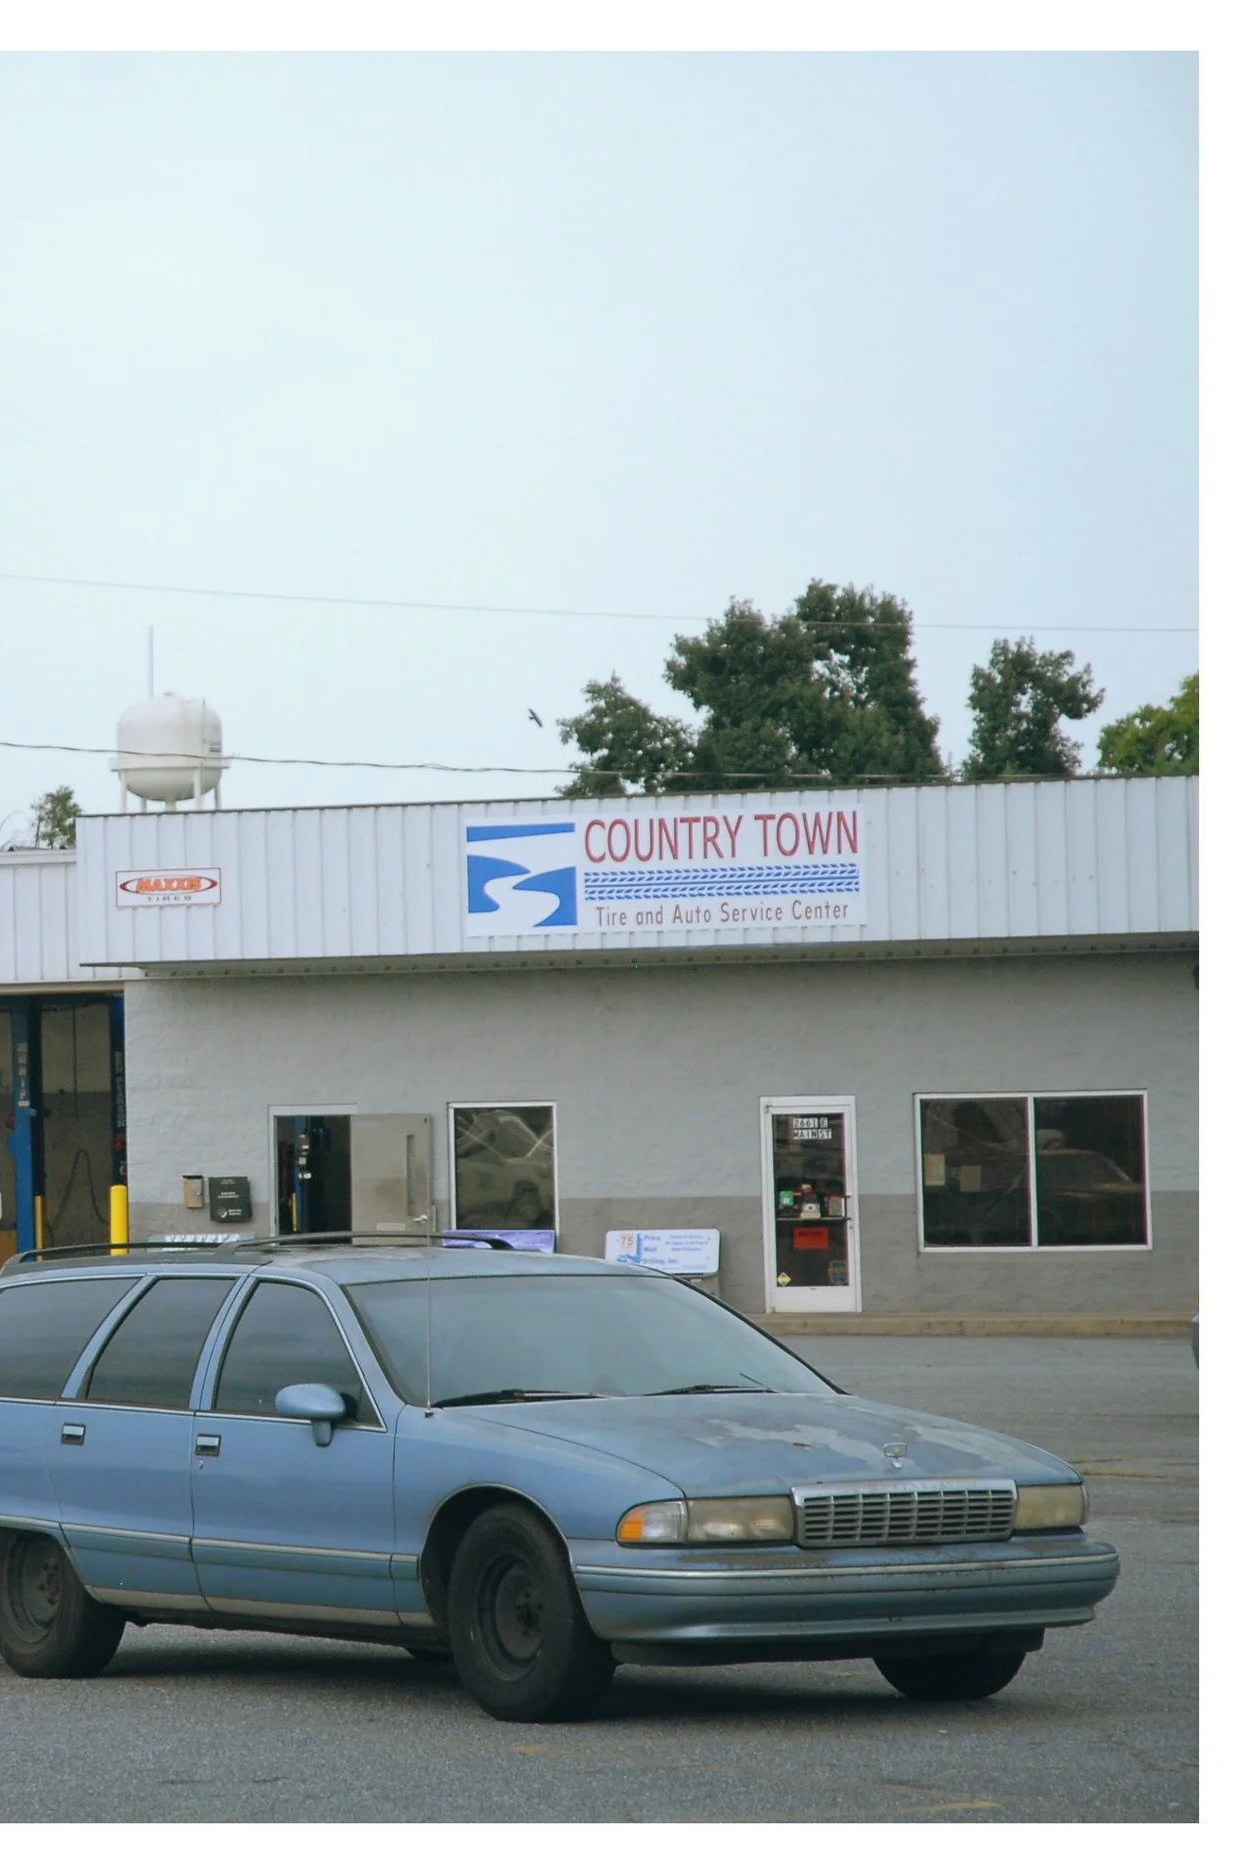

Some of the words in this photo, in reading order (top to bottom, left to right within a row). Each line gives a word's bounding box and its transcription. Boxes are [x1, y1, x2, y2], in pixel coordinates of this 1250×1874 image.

[584, 814, 744, 863] COUNTRY
[753, 810, 859, 857] TOWN
[135, 875, 202, 894] MAXXIS
[595, 905, 628, 927] Tire
[635, 905, 664, 925] and
[672, 903, 712, 925] Auto
[719, 901, 783, 923] Service
[791, 899, 850, 921] Center
[793, 1118, 818, 1128] 2661
[793, 1129, 818, 1139] MAIN
